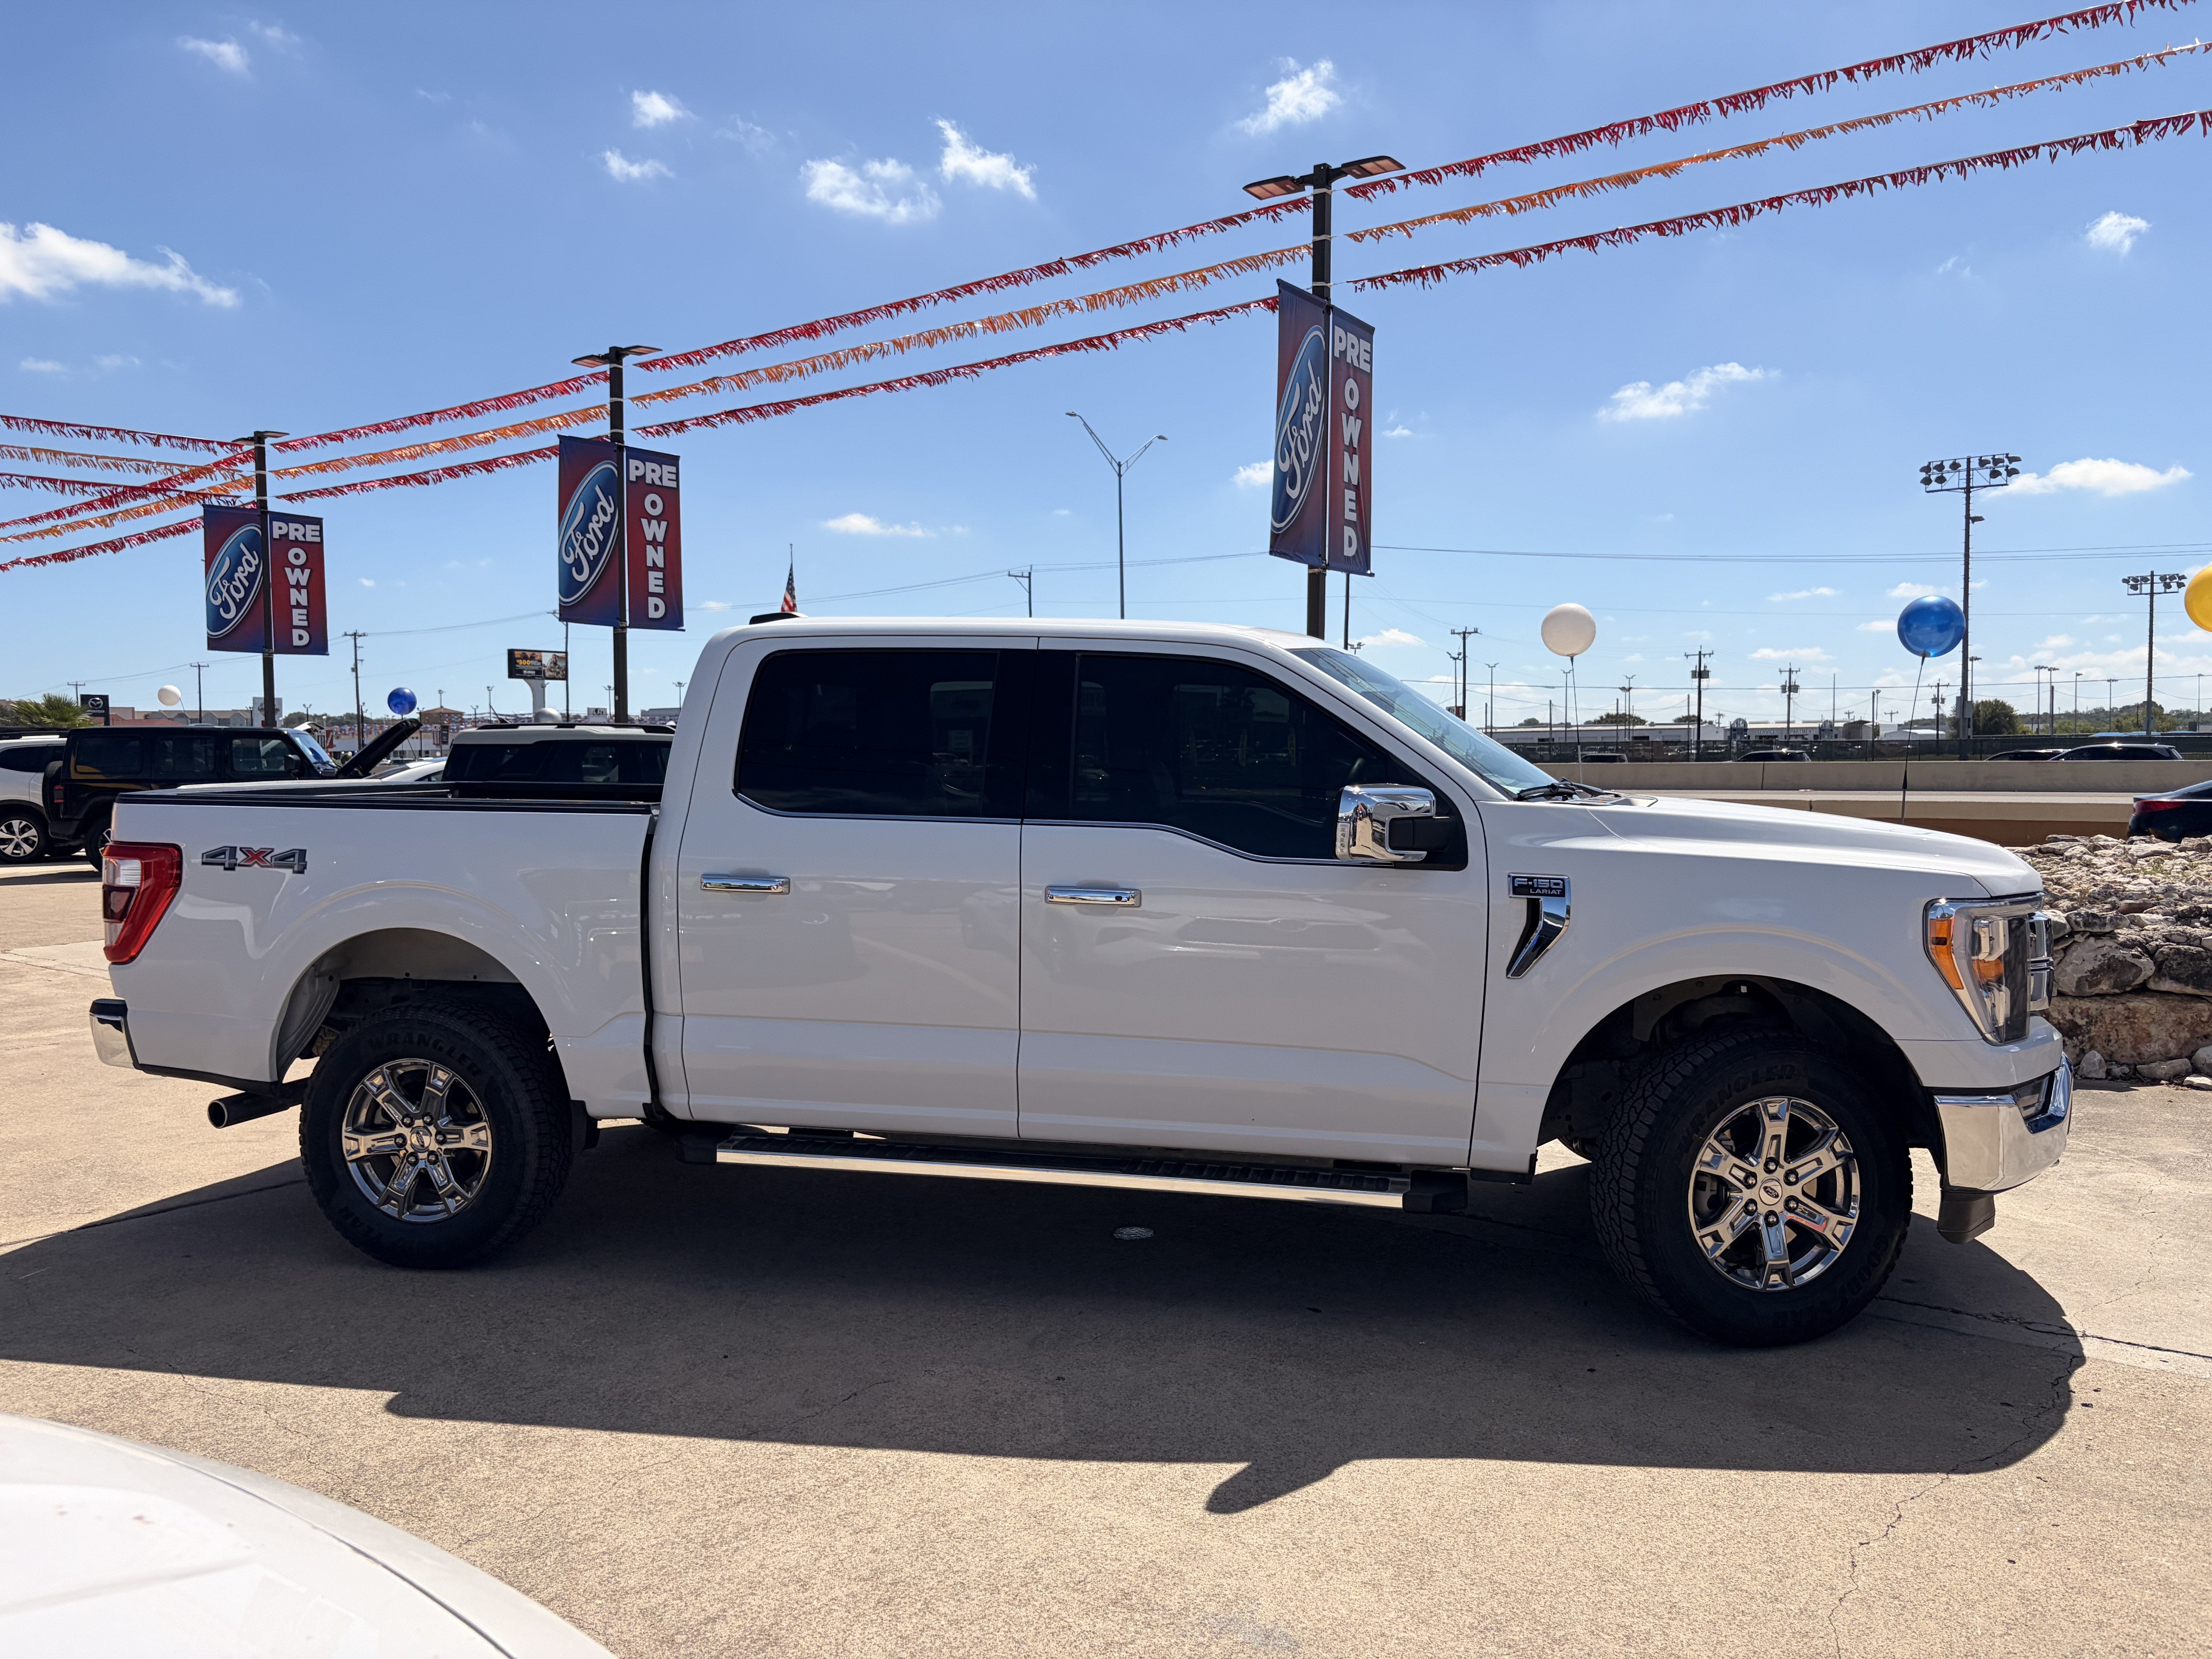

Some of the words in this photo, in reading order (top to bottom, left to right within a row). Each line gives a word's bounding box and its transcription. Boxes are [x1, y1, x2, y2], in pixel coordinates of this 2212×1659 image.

[1334, 325, 1371, 373] PRE
[1278, 359, 1321, 499] Ford
[1341, 378, 1362, 556] OWNED
[629, 459, 677, 488] PRE
[272, 521, 321, 542] PRE
[562, 484, 615, 582] Ford
[641, 493, 668, 618] OWNED
[210, 543, 259, 619] Ford
[284, 548, 311, 646] OWNED
[1514, 878, 1563, 888] F-150
[368, 1032, 483, 1077] WRANGLER
[1677, 1064, 1796, 1154] WRANGLER
